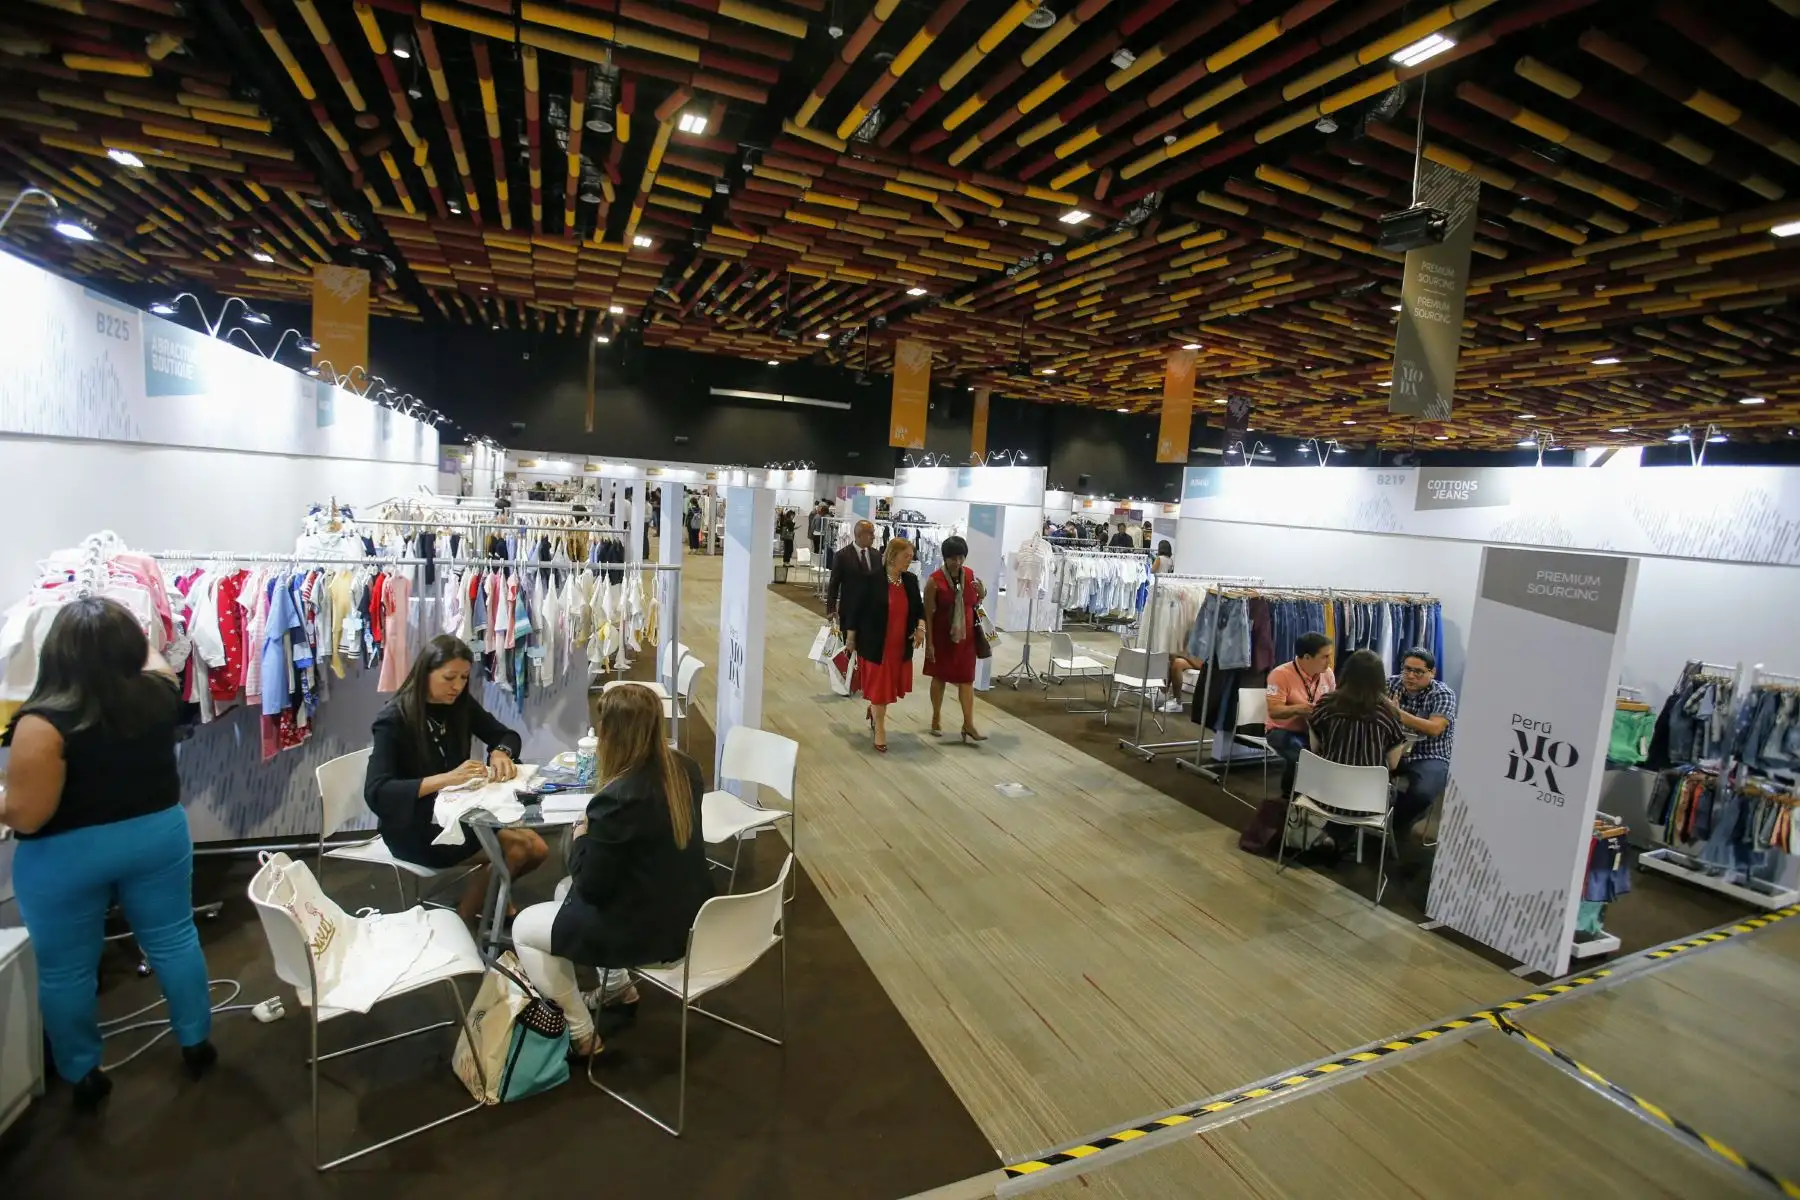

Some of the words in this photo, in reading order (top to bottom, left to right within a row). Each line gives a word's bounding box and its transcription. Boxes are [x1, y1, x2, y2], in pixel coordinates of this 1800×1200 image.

[1421, 260, 1455, 277] PREMIUM
[1417, 272, 1455, 291] SOURCING
[1417, 296, 1450, 311] PREMIUM
[1414, 307, 1451, 324] SOURCING
[96, 311, 130, 342] B225
[152, 354, 194, 380] BOUTIQUE
[1427, 479, 1478, 491] COTTONS
[1432, 489, 1469, 500] JEANS
[1536, 570, 1601, 586] PREMIUM
[1526, 582, 1600, 601] SOURCING
[1536, 790, 1566, 808] 2019
